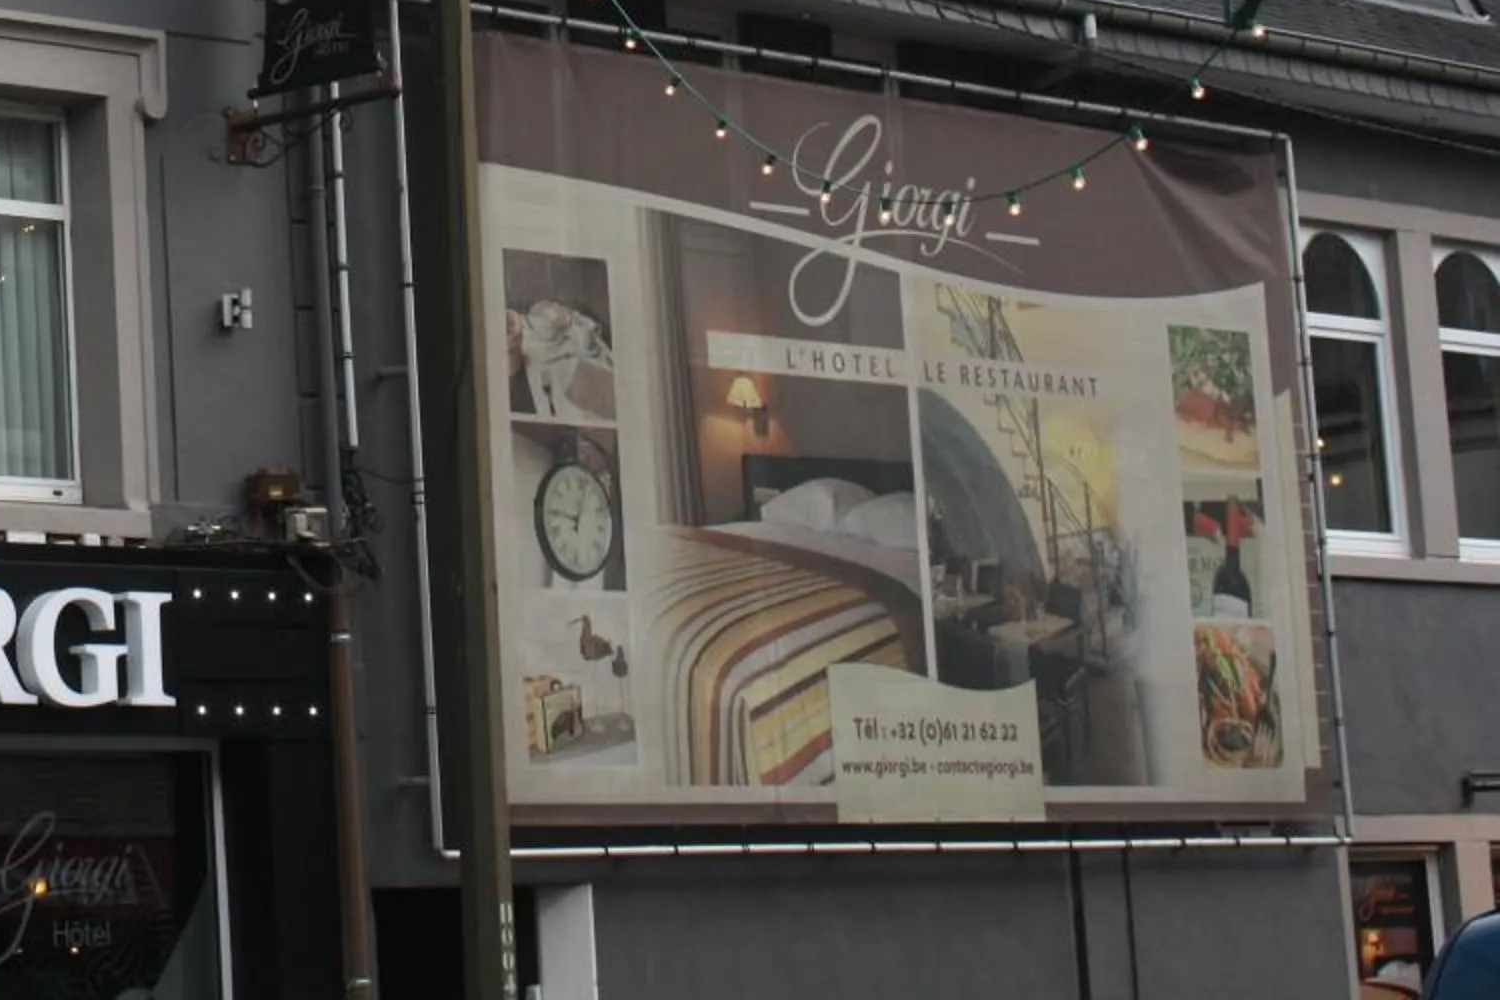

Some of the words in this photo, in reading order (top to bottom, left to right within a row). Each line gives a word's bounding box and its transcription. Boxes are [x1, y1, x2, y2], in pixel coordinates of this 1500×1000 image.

[789, 114, 1020, 327] Giorgi
[786, 347, 896, 379] L'HOTEL
[923, 359, 947, 384] LE
[960, 364, 1100, 397] RESTAURANT
